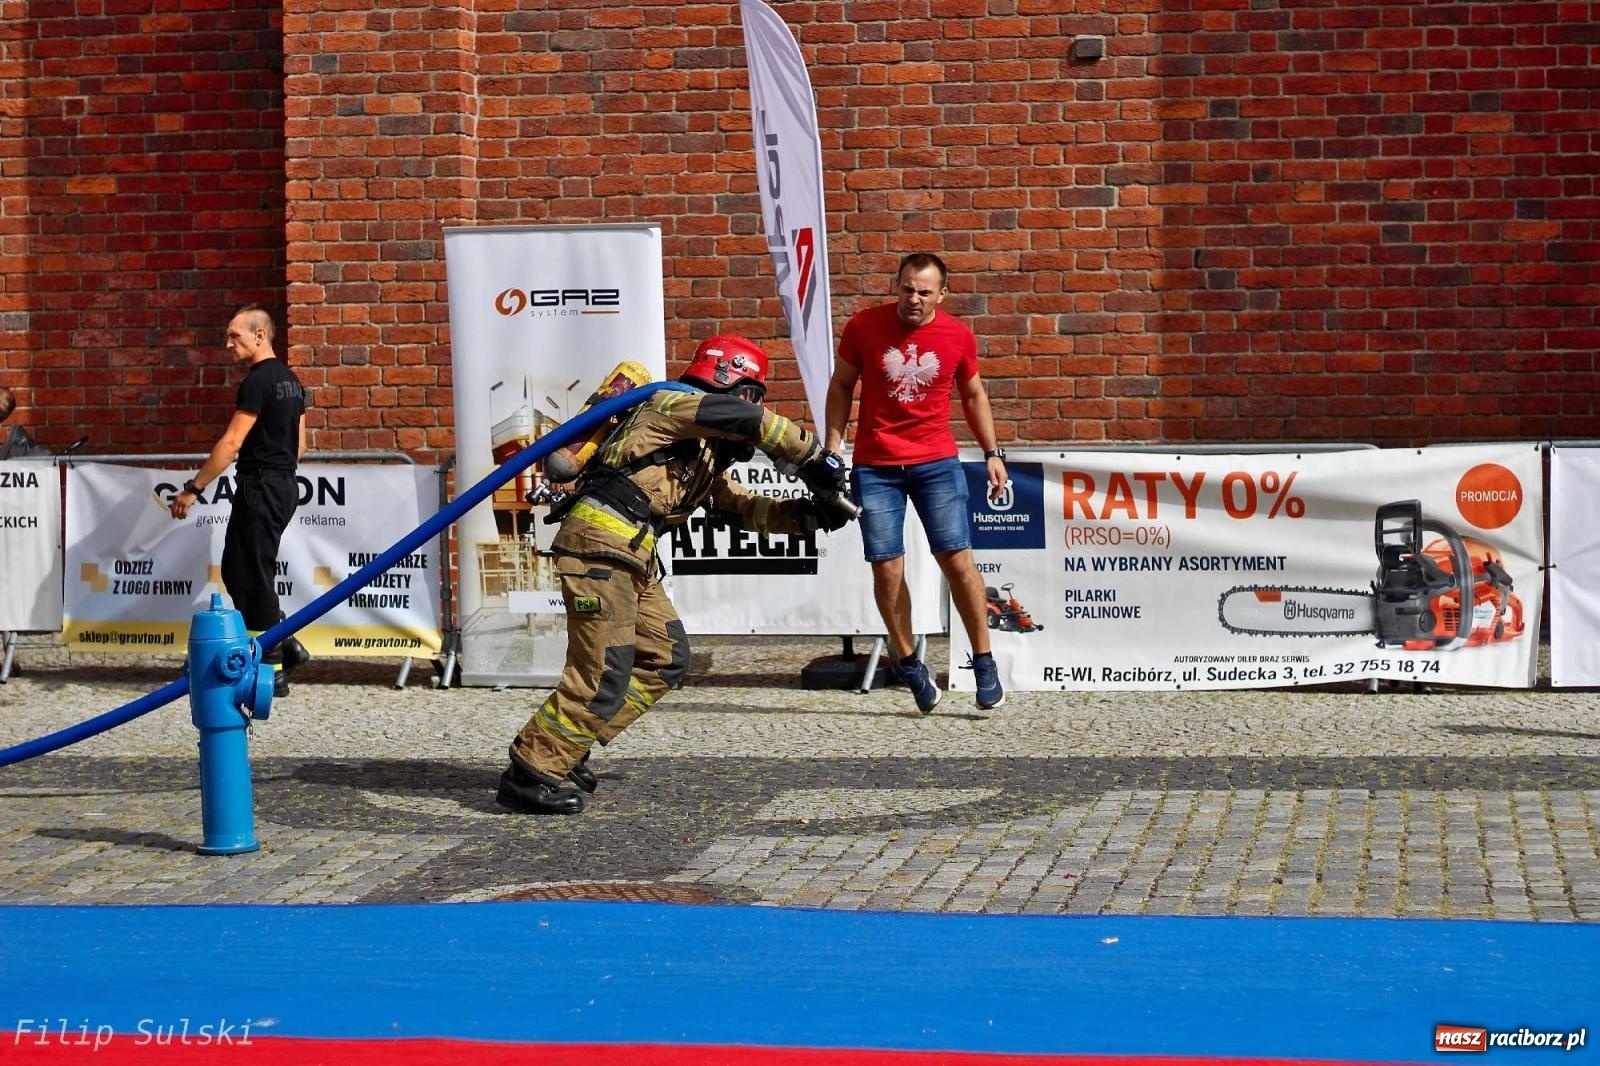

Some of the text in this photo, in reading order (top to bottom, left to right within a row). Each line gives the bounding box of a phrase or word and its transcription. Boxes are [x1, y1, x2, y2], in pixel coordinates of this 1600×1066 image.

[530, 289, 620, 306] GAZ
[530, 308, 579, 317] system
[0, 472, 39, 488] ZNA
[1062, 470, 1306, 520] RATY 0%
[1460, 490, 1518, 502] PROMOCJA
[300, 513, 346, 526] reklama
[973, 512, 1030, 524] Husqvarna
[1063, 525, 1171, 549] (RRSO=0%)
[114, 558, 154, 575] ODZIEŻ
[1064, 556, 1287, 572] NA WYBRANY ASORTYMENT
[112, 580, 192, 595] Z LOGO FIRMY
[1065, 589, 1116, 602] PILARKI
[1064, 606, 1141, 619] SPALINOWE
[1297, 603, 1355, 621] Husqvarna
[79, 631, 175, 645] sklep@gravton.pl
[334, 637, 422, 648] www.gravton.pl
[1173, 655, 1310, 663] AUTORYZOWANY DILER ORAZ SERWIS
[1101, 666, 1177, 684] Racibórz,
[1182, 666, 1201, 682] ul.
[1206, 666, 1277, 682] Sudecka
[1303, 665, 1327, 678] tel.
[1333, 662, 1355, 675] 32
[1360, 659, 1391, 672] 755
[1398, 660, 1415, 673] 18
[1420, 660, 1441, 673] 74
